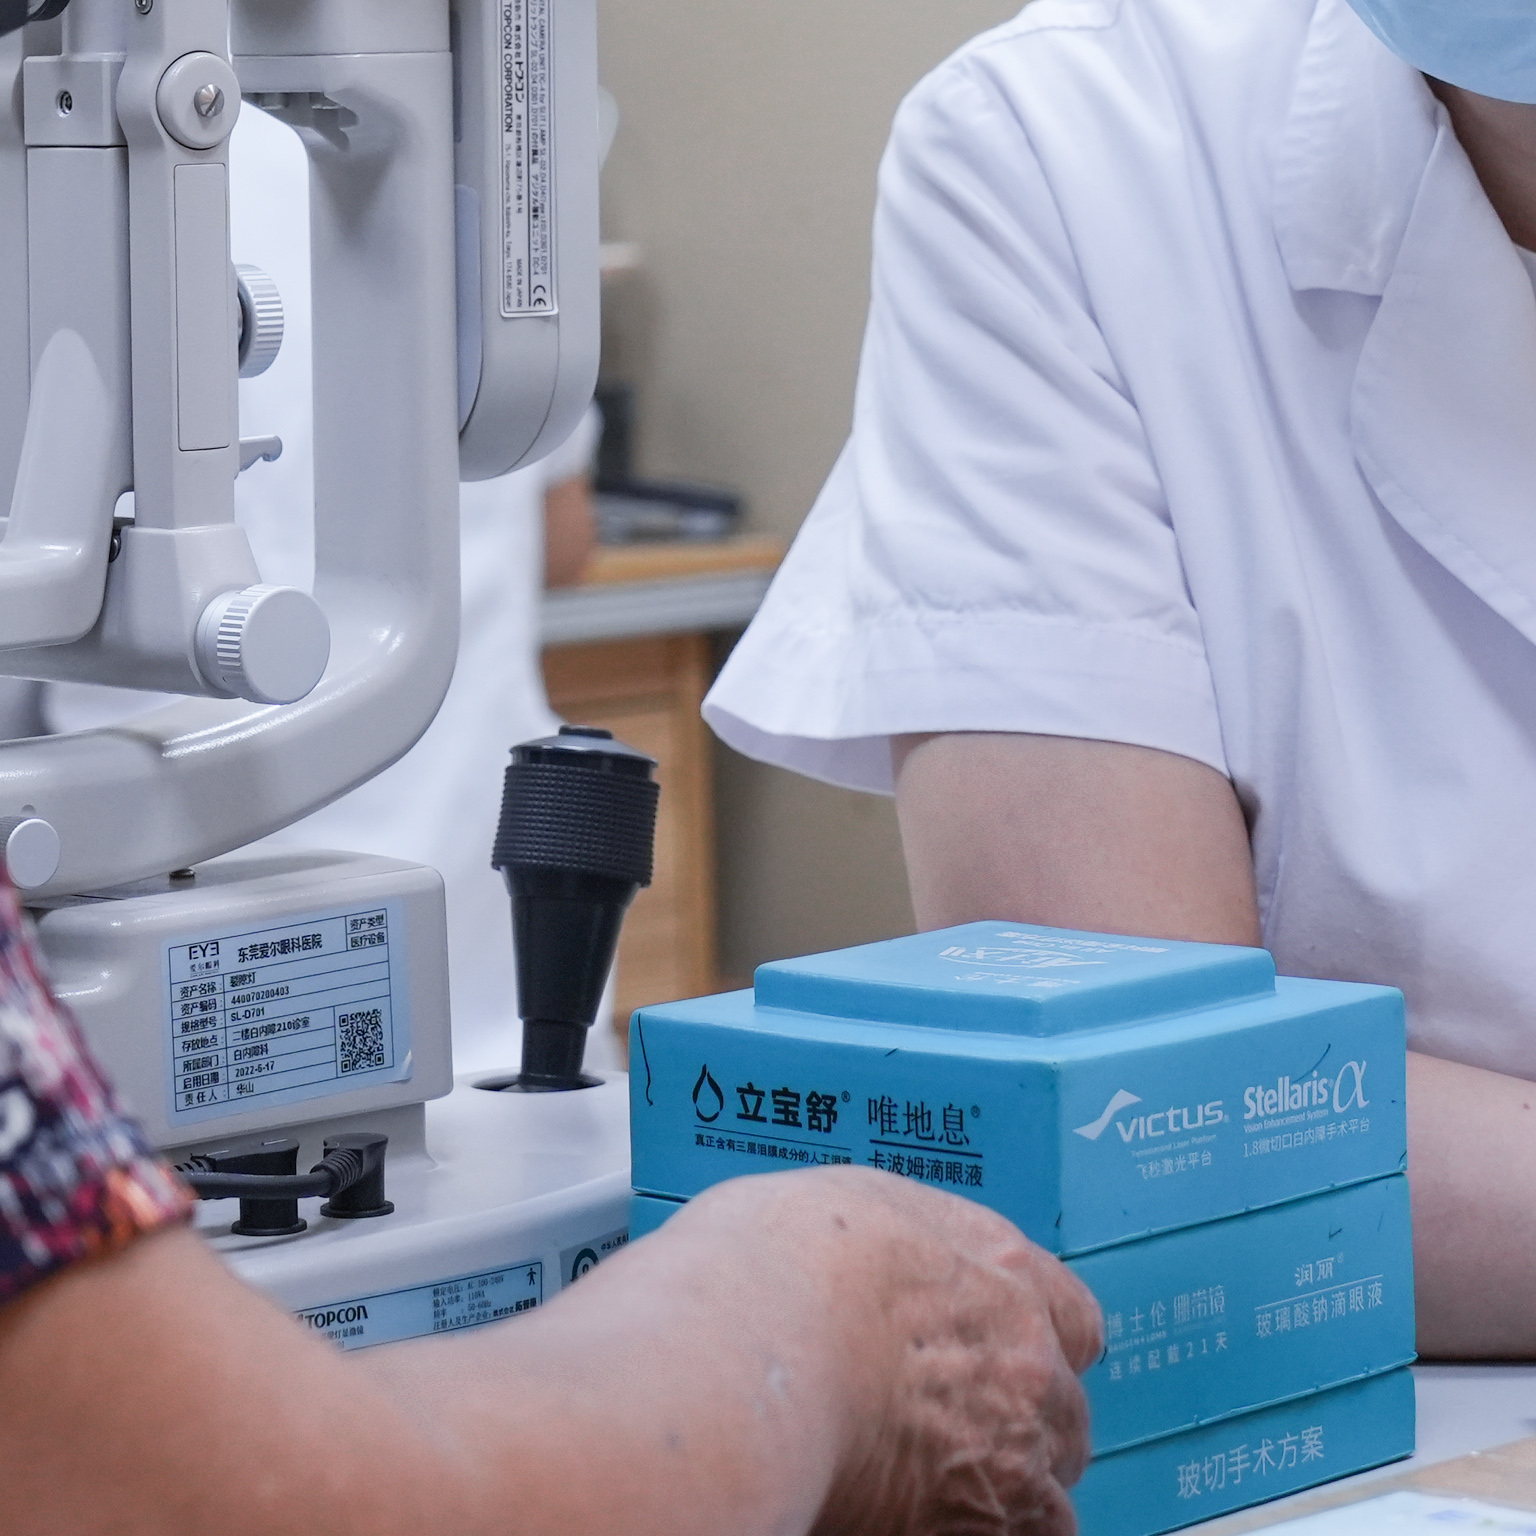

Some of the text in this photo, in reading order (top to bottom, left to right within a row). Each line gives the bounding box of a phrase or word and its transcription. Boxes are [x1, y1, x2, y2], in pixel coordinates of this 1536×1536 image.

[503, 3, 513, 50] TOPCON
[504, 52, 513, 133] CORPORATION
[350, 914, 385, 931] 资产类型
[188, 941, 220, 960] EYE
[237, 933, 323, 963] 东莞爱尔眼科医院
[350, 932, 385, 948] 医疗设备
[229, 971, 256, 988] 裂隙灯
[230, 986, 290, 1005] 440070200403
[230, 1007, 265, 1022] SL-D701
[232, 1016, 311, 1042] 二楼白内障210诊室
[233, 1043, 270, 1061] 白内障科
[236, 1081, 254, 1095] 华山
[1263, 1115, 1306, 1131] Enhancement
[1306, 1109, 1329, 1123] System
[1242, 1116, 1371, 1158] 1.8微切口白内障手术平台
[867, 1149, 983, 1187] 卡波姆滴眼液
[1136, 1150, 1213, 1180] 飞秒激光平台
[1106, 1300, 1167, 1340] 博士伦
[1255, 1282, 1383, 1338] 玻璃酸钠滴眼液
[1176, 1425, 1325, 1500] 玻切手术方案
